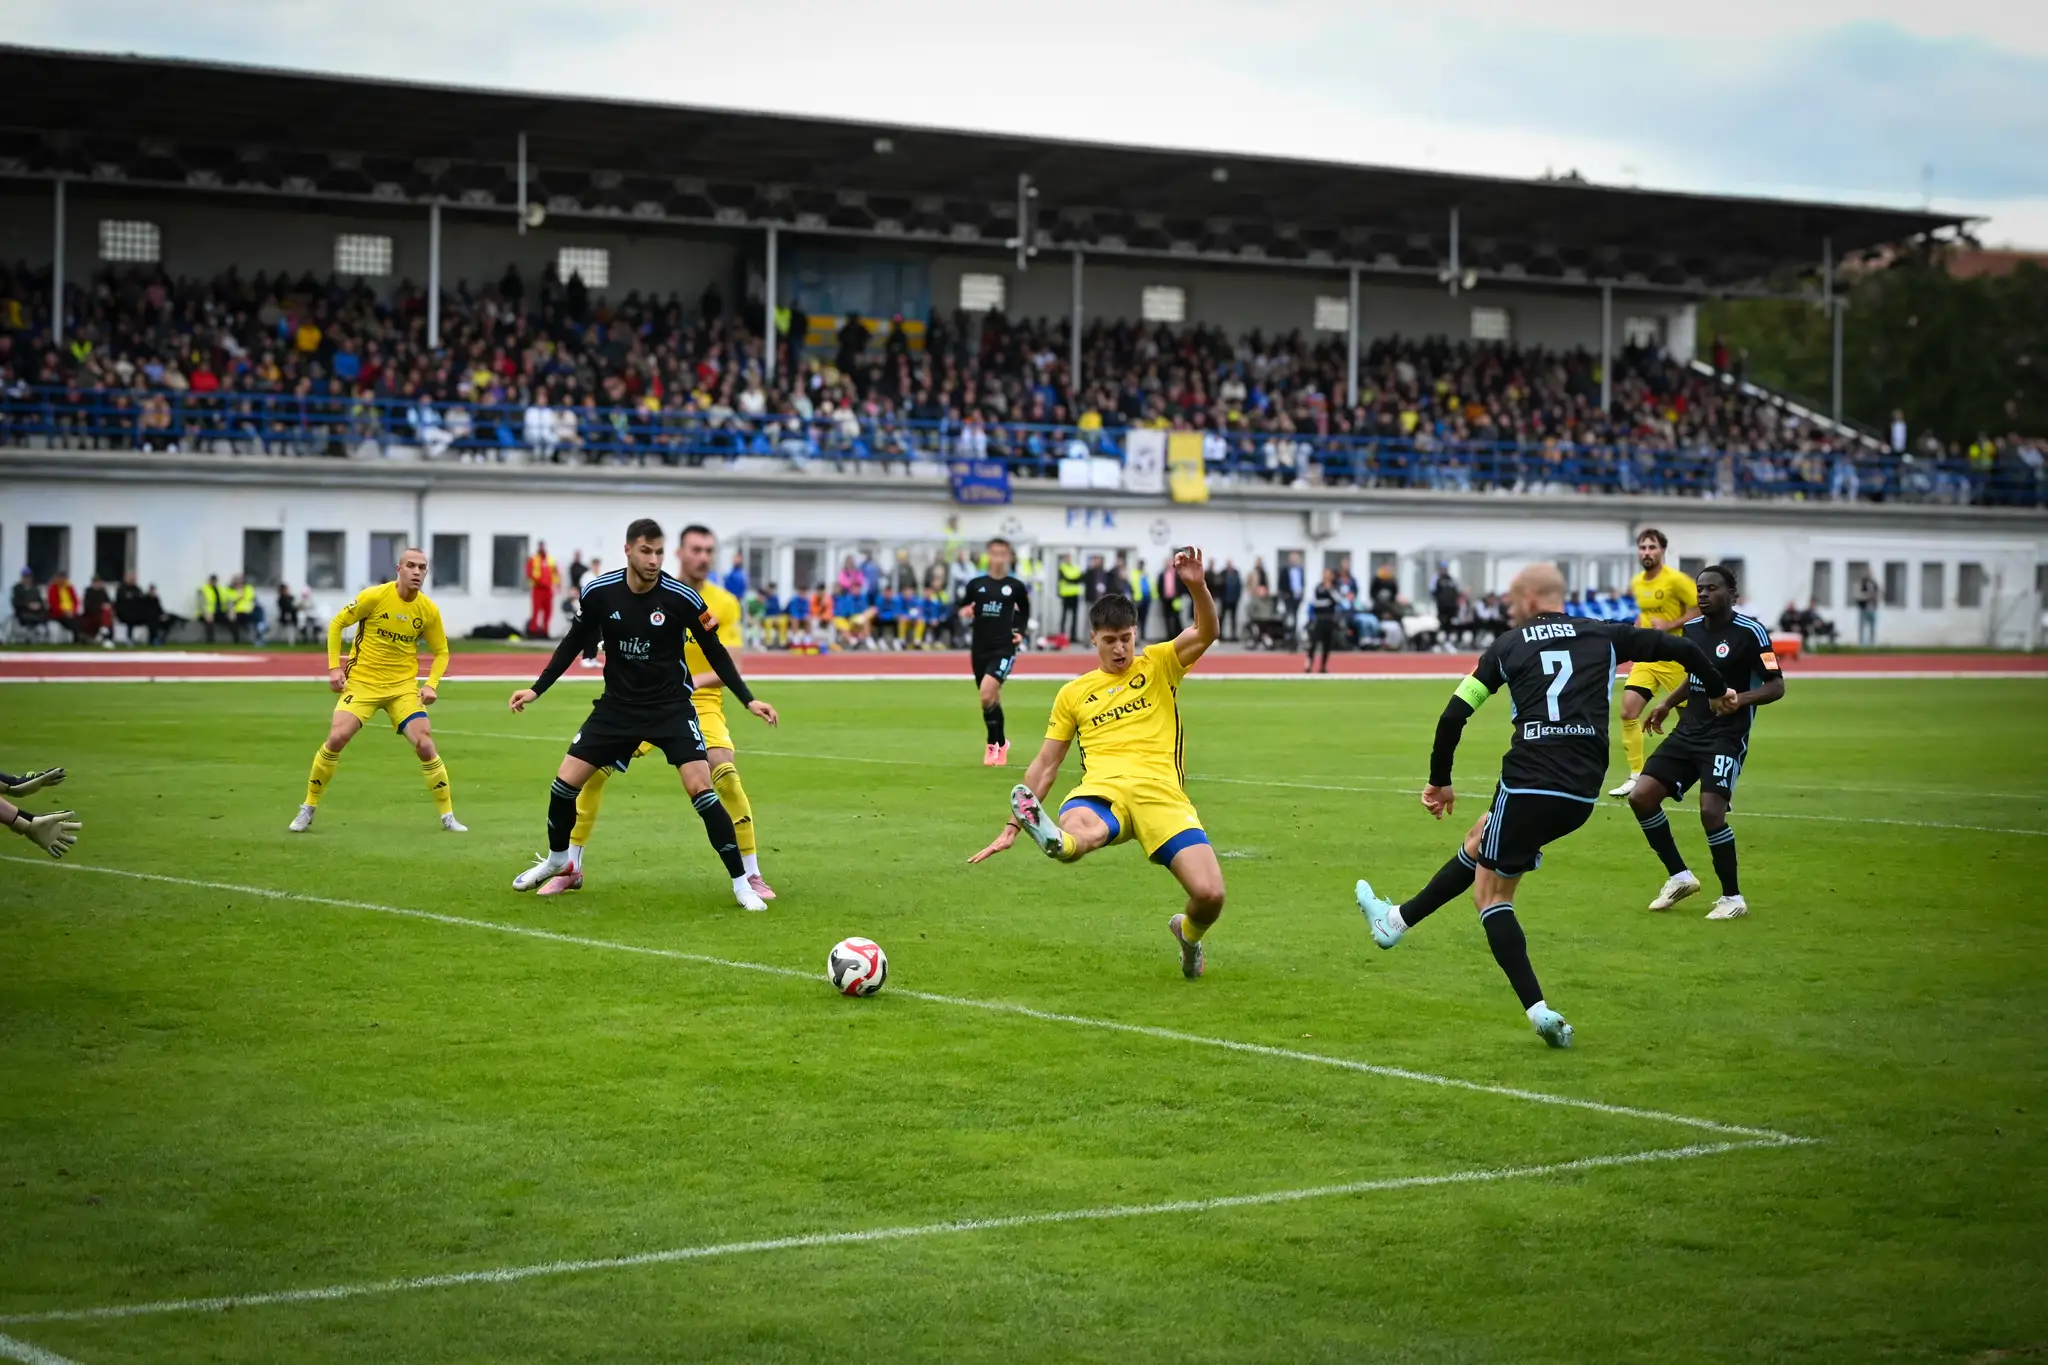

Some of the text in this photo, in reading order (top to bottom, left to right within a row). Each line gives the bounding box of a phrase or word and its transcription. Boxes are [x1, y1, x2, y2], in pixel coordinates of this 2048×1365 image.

[1521, 623, 1577, 643] WEISS
[619, 636, 651, 653] niké
[1540, 650, 1573, 721] 7
[344, 695, 353, 704] 4
[1091, 696, 1152, 727] respect.
[688, 720, 701, 741] 9
[1541, 724, 1596, 736] grafobal
[1713, 754, 1734, 777] 97
